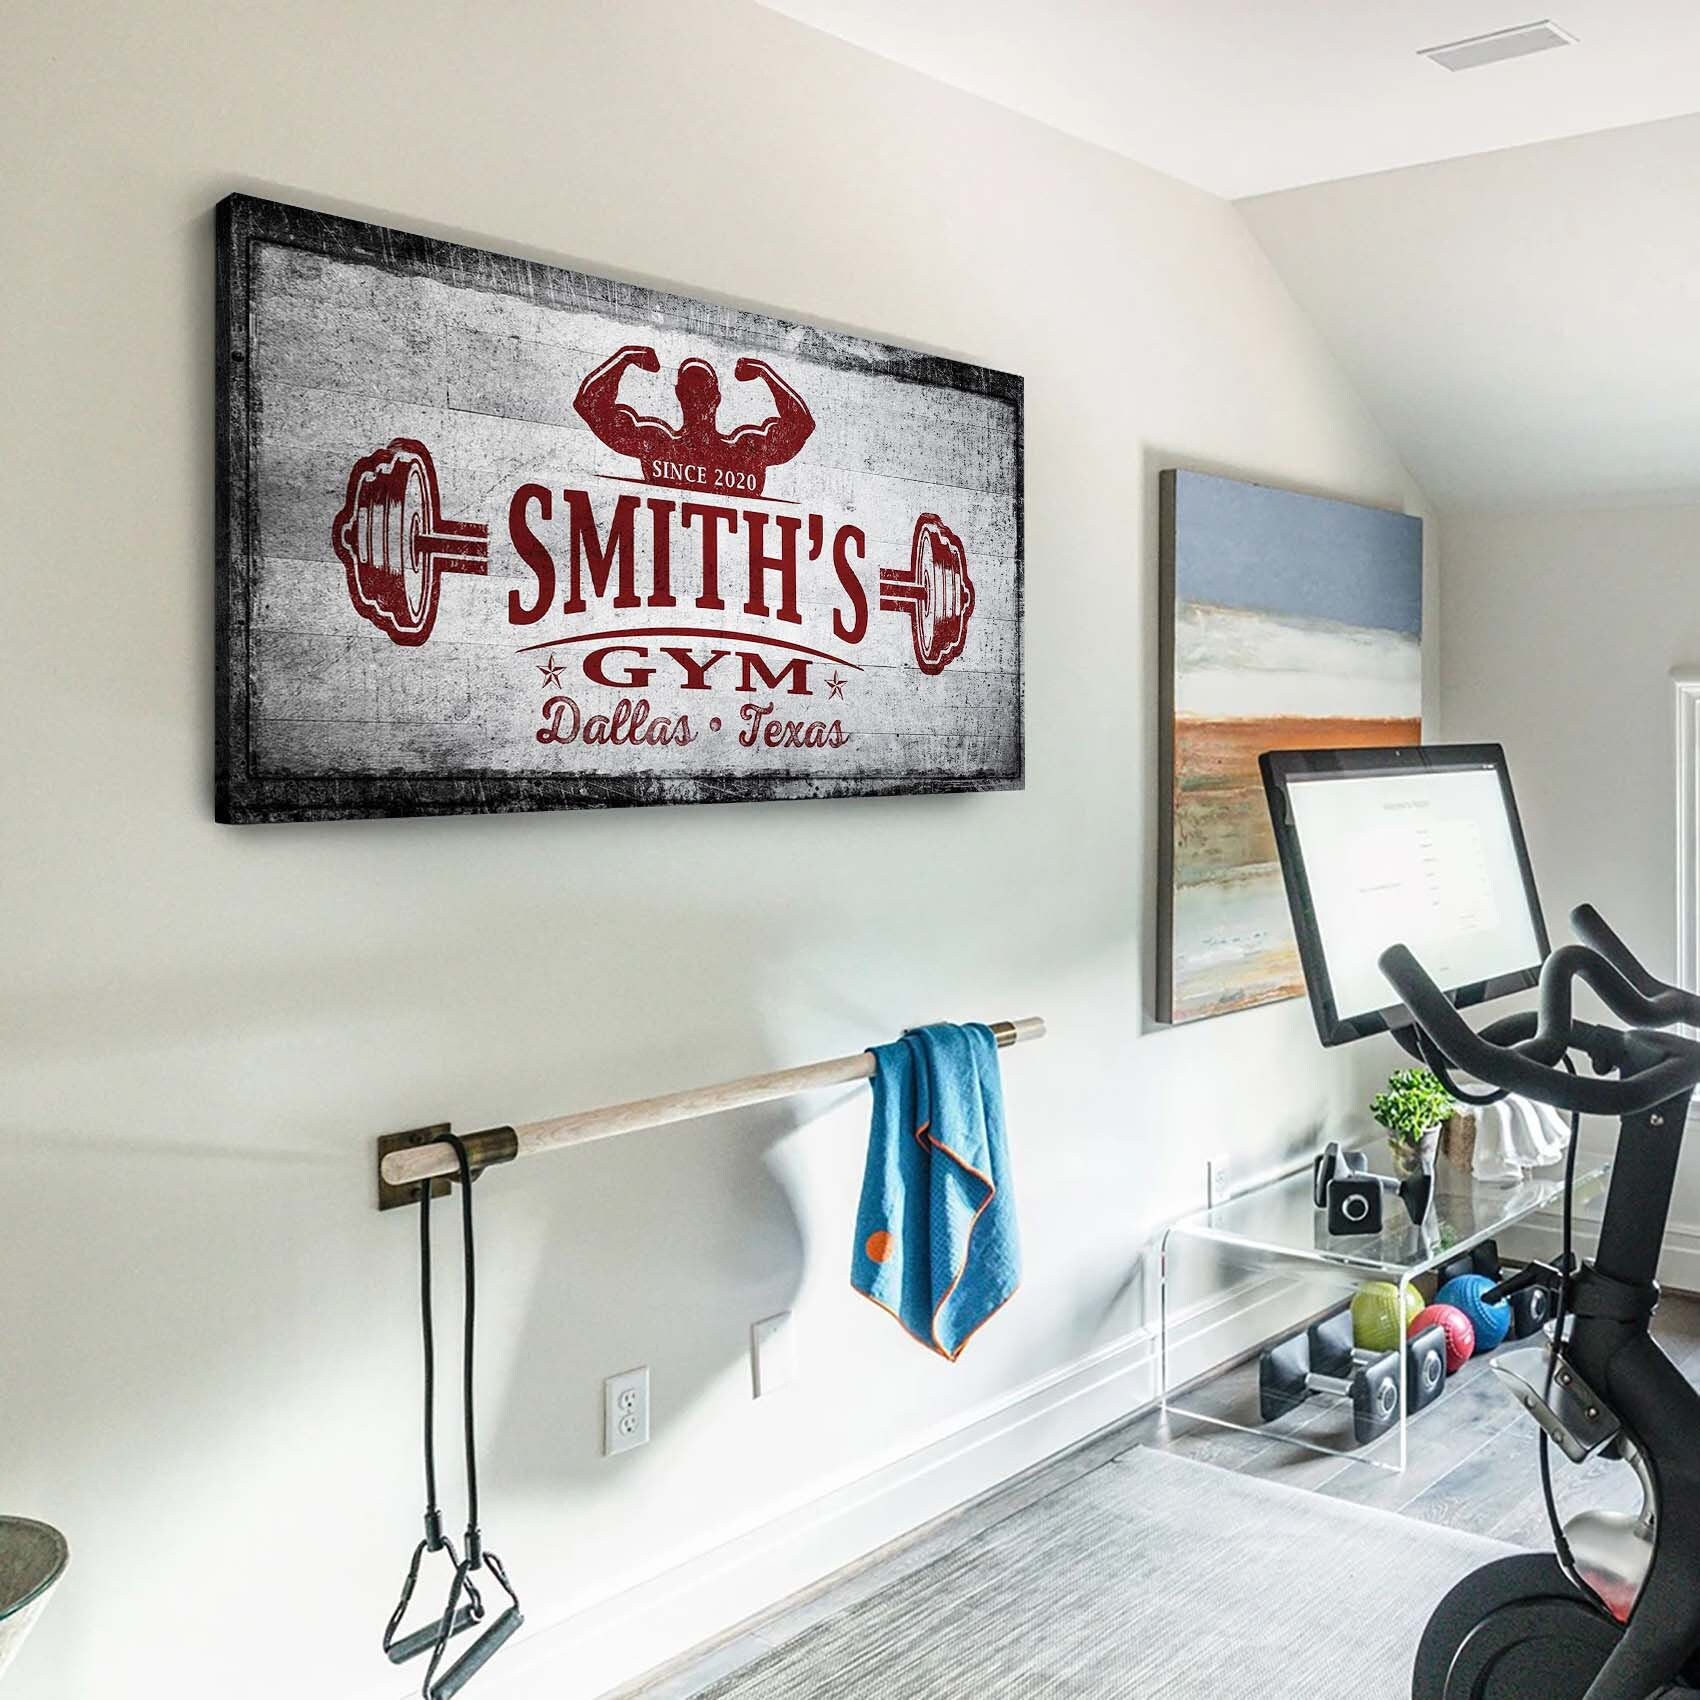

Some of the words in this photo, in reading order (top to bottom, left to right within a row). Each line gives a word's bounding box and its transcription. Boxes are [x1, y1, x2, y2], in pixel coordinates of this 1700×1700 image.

[652, 459, 707, 484] SINCE
[714, 469, 757, 490] 2020
[508, 483, 868, 644] SMITH'S
[582, 646, 813, 696] GYM
[536, 696, 697, 746] Dallas
[739, 703, 849, 747] Texas
